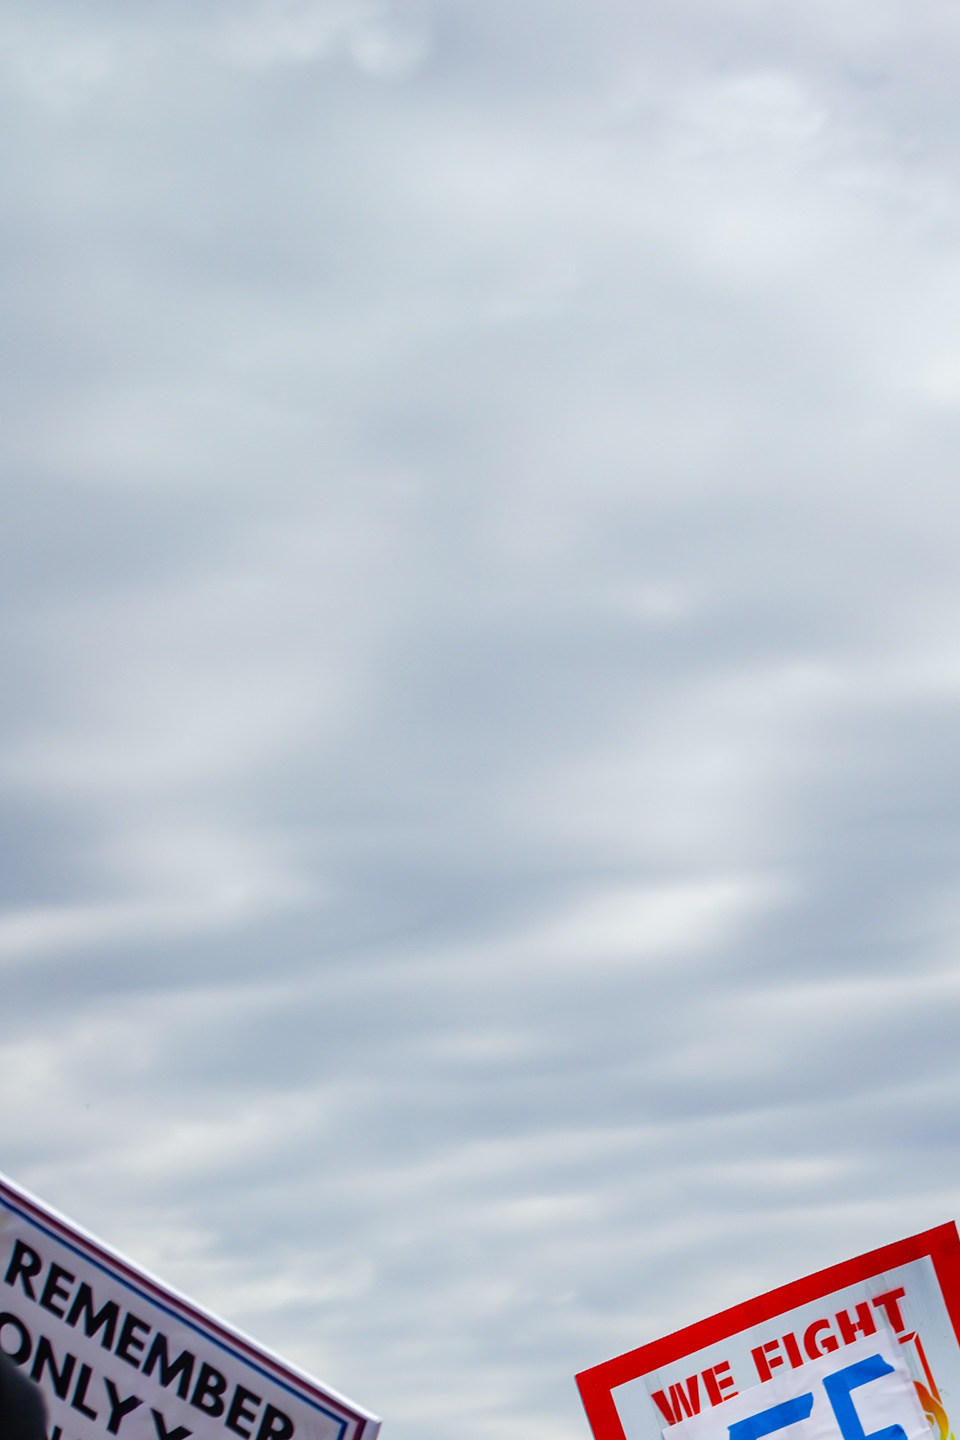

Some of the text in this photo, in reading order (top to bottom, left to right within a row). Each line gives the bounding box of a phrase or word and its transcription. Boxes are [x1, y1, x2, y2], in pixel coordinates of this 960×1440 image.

[0, 1312, 144, 1436] ONLY
[651, 1287, 906, 1426] WE FIGHT
